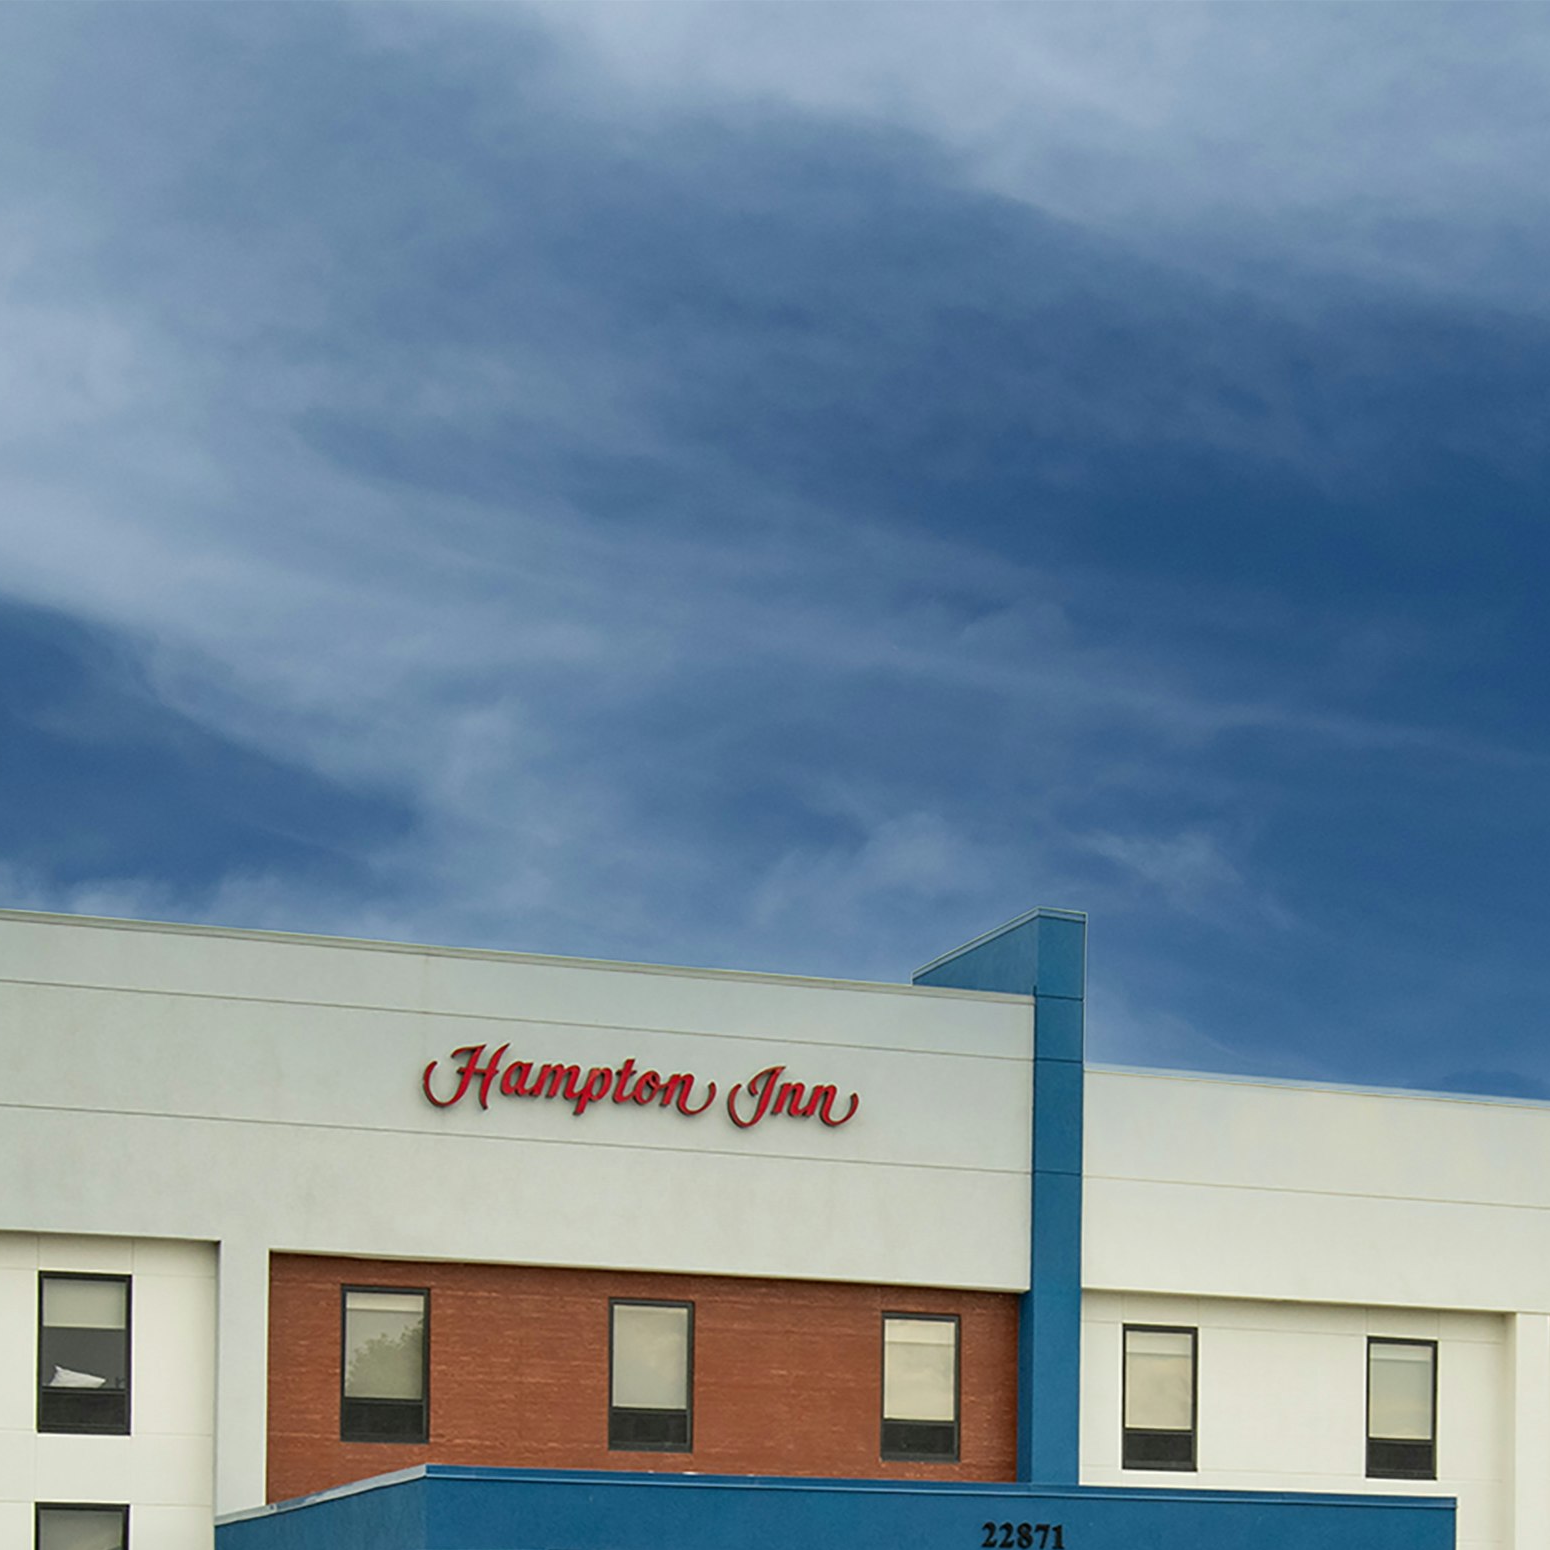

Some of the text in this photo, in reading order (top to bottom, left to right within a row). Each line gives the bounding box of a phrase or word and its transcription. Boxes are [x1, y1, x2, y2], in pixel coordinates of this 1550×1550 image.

[422, 1042, 860, 1128] Hampton Inn
[980, 1521, 1066, 1550] 22871
